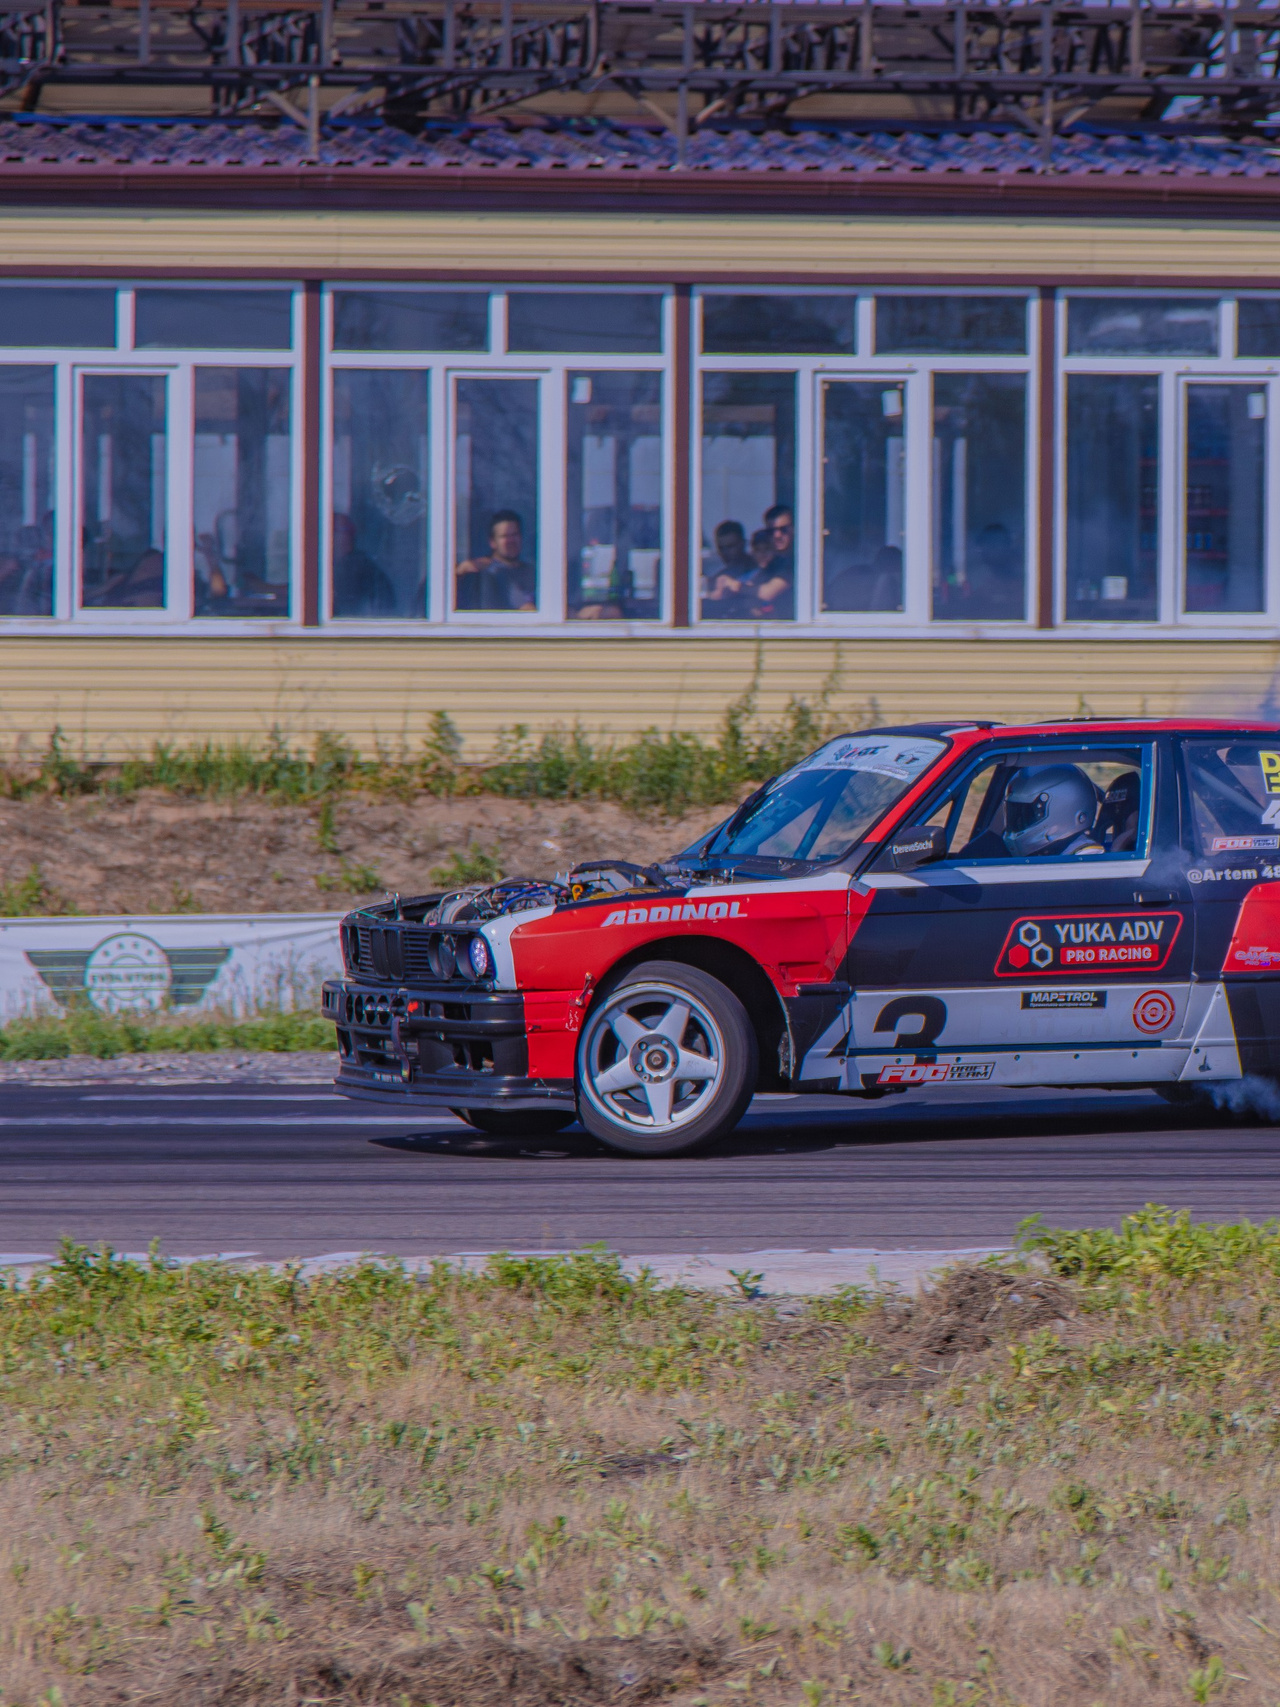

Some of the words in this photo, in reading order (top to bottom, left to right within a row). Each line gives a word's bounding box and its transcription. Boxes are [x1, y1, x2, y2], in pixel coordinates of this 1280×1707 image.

[1187, 867, 1258, 884] @Artem
[600, 901, 748, 928] ADDINOL
[1054, 921, 1117, 944] YUKA
[1118, 920, 1164, 942] ADV
[1066, 949, 1095, 963] PRO
[1099, 947, 1152, 961] RACING
[1030, 992, 1098, 1003] MAPETROL
[880, 1064, 950, 1082] FDC
[950, 1065, 992, 1073] DRIFT
[950, 1071, 989, 1079] TEAM
